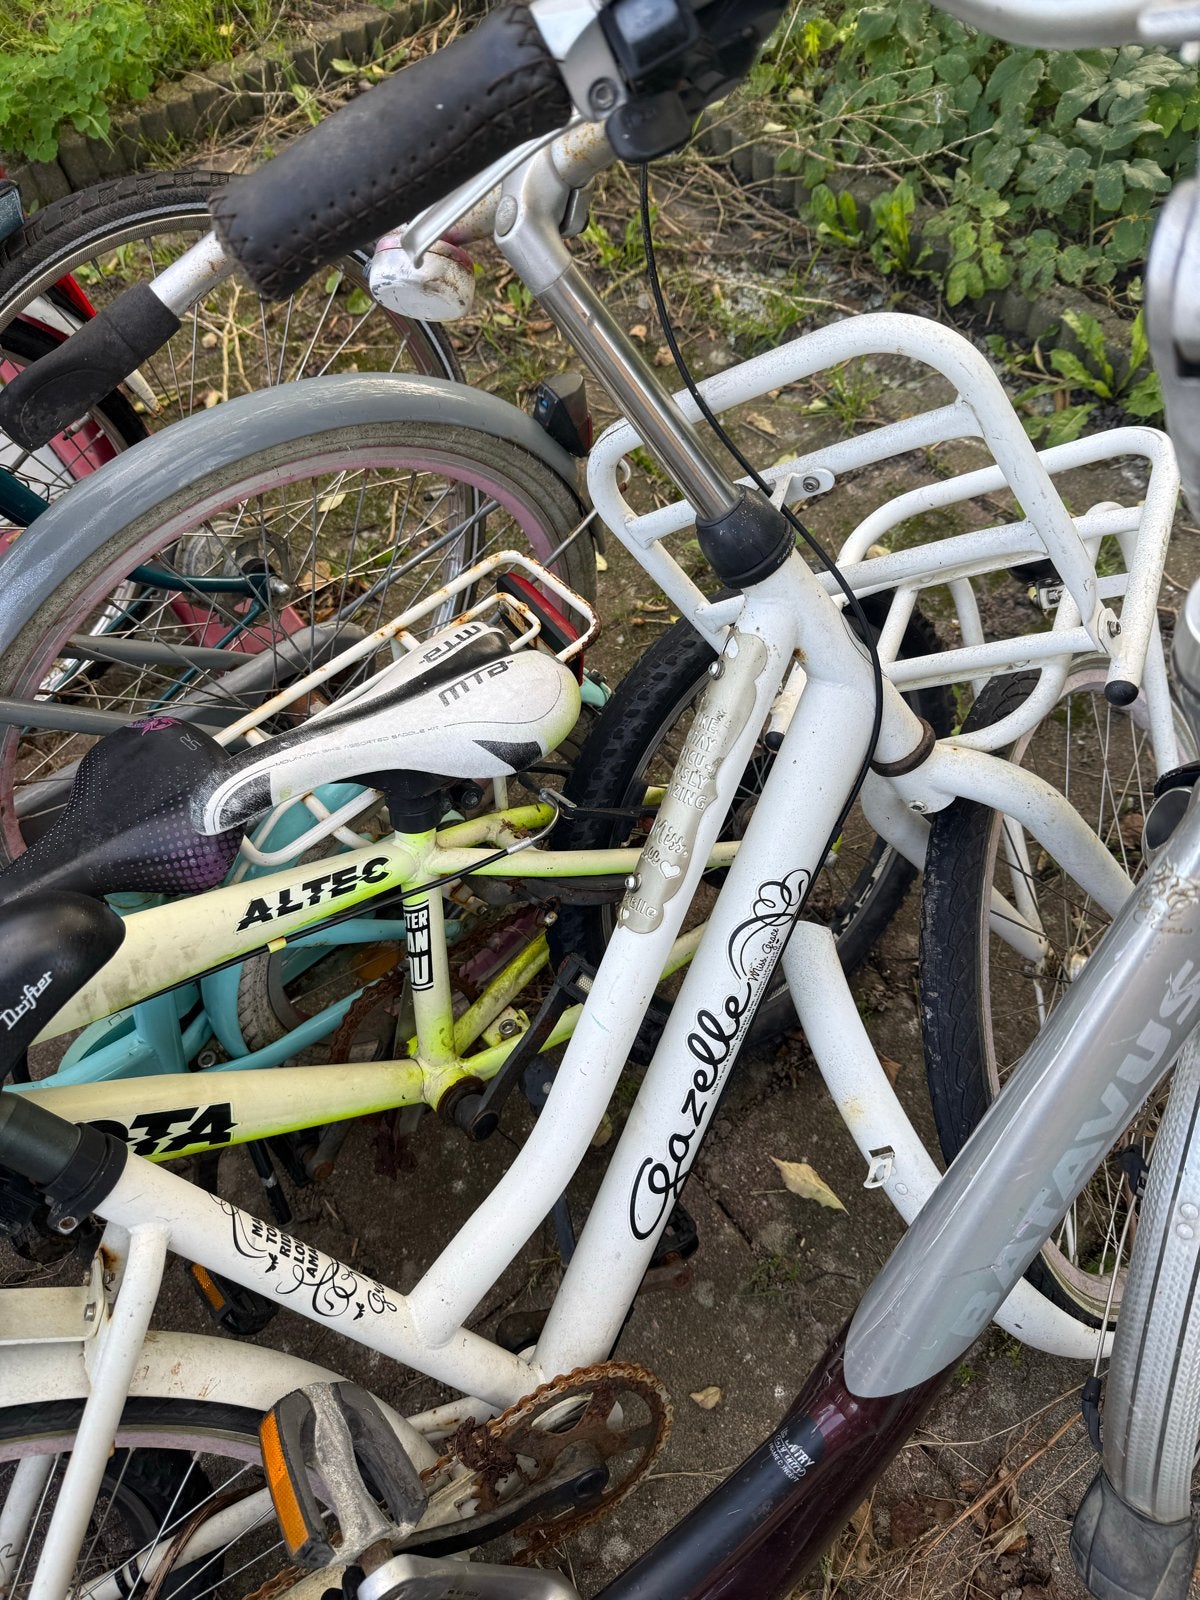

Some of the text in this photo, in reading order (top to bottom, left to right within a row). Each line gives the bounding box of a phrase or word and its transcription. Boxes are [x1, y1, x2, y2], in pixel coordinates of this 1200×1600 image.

[236, 857, 390, 932] ALTEC
[404, 909, 428, 929] TER
[407, 928, 428, 953] AN
[747, 955, 770, 982] Miss.
[762, 928, 780, 955] Grace
[0, 971, 53, 1031] Drifter
[629, 982, 752, 1241] Gazelle
[951, 958, 1200, 1339] BATAVUS
